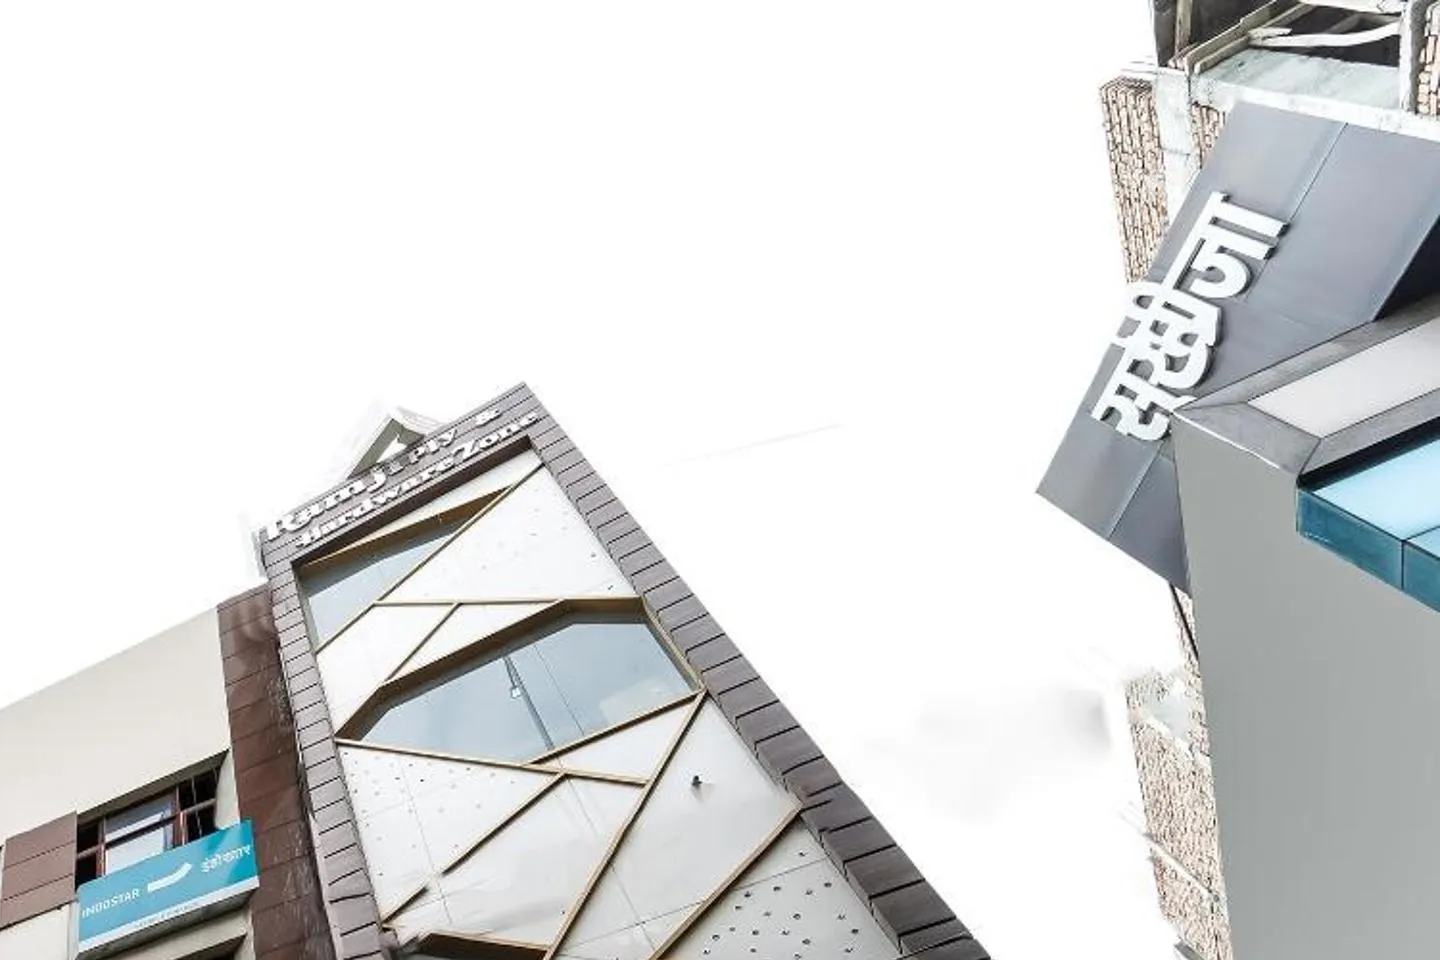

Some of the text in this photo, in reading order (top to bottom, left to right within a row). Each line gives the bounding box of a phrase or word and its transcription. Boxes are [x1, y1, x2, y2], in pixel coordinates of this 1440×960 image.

[296, 411, 540, 548] Hardware Zone
[81, 887, 141, 919] INDOSTAR
